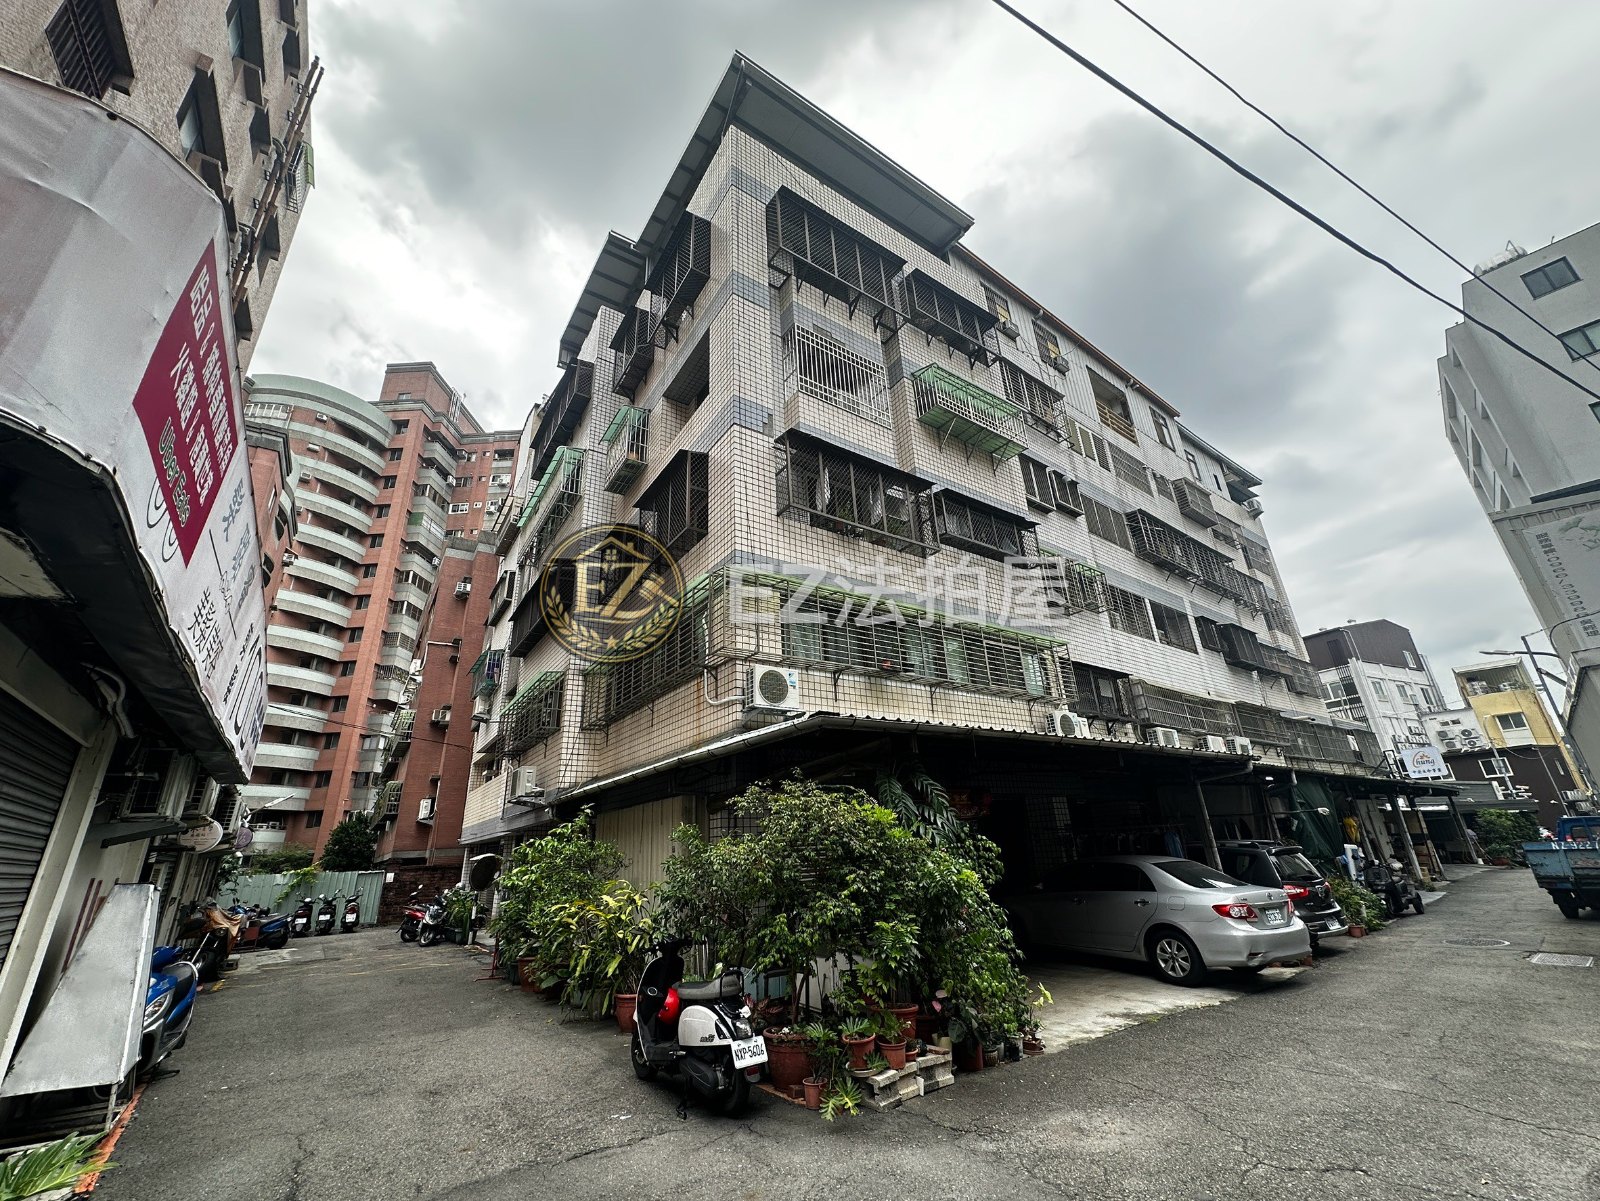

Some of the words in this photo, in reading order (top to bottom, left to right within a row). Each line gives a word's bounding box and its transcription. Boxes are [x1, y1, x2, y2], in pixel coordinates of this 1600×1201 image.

[158, 416, 180, 488] Uber
[172, 470, 191, 528] Eats
[734, 1043, 765, 1062] NXP-5606
